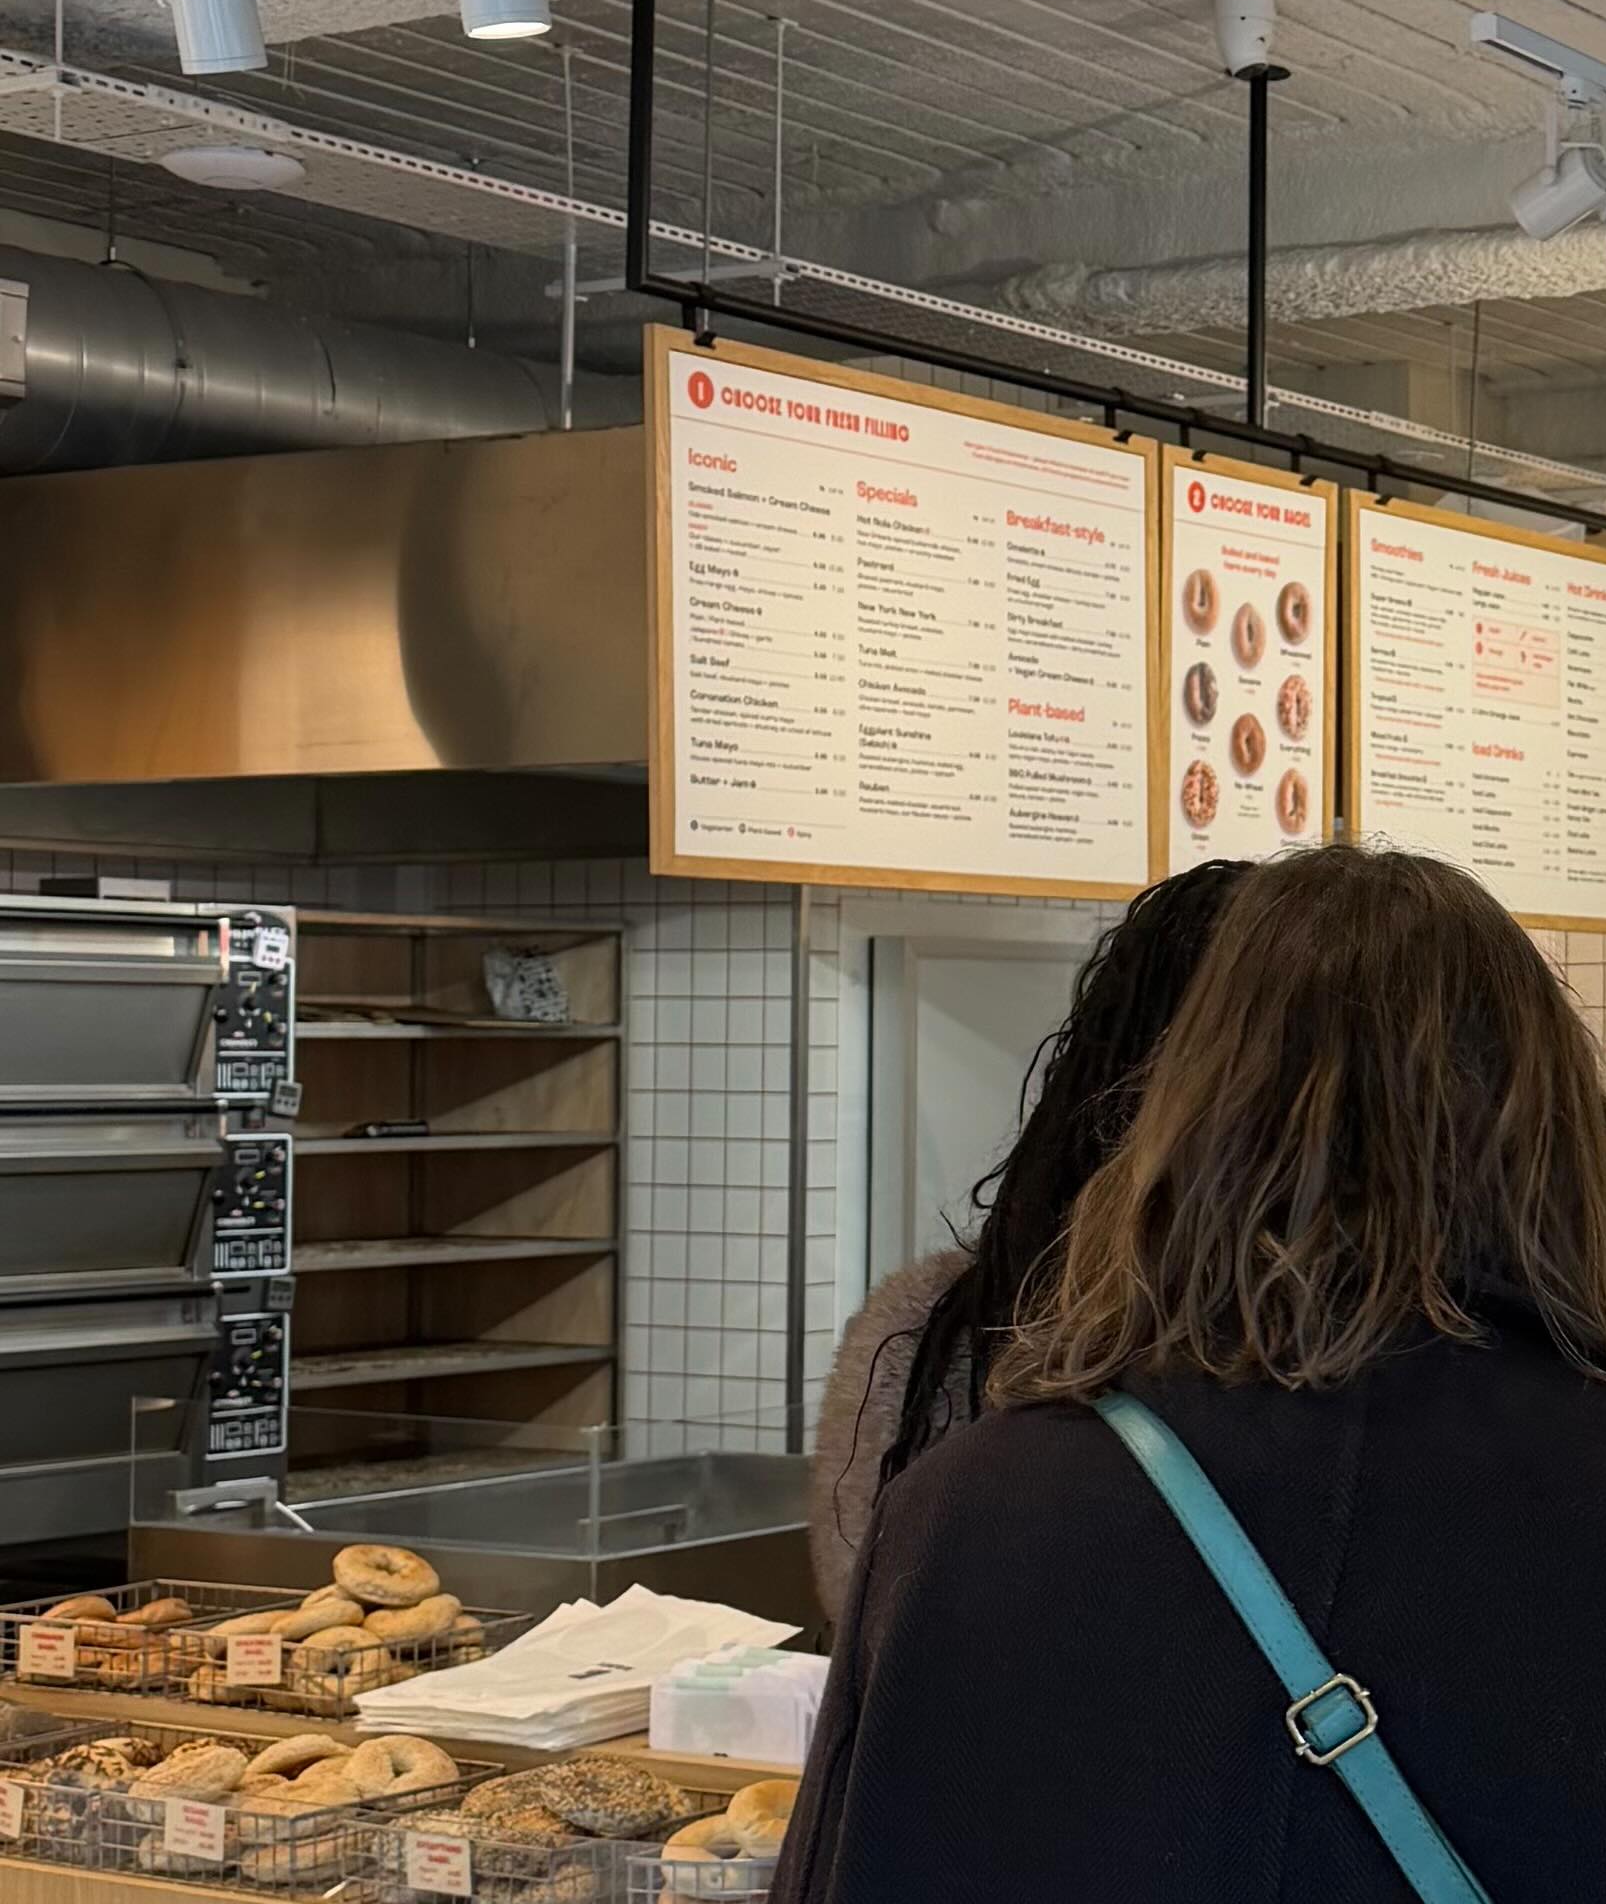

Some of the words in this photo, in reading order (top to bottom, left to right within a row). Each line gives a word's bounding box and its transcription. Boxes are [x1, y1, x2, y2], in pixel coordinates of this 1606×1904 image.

[721, 386, 781, 416] CHOOSE
[788, 401, 820, 424] YOUR
[826, 408, 859, 433] FRESH
[865, 417, 909, 442] FILLING
[687, 446, 736, 473] Iconic
[856, 480, 918, 508] Specials
[1210, 493, 1253, 517] CHOOSE
[1257, 503, 1281, 521] YOUR
[1284, 508, 1312, 528] BAGEL
[1006, 509, 1105, 545] Breakfast-style
[1371, 537, 1422, 562] Smoothies
[689, 560, 704, 574] Egg
[1472, 559, 1498, 578] Fresh
[1567, 582, 1581, 596] Hot
[689, 596, 719, 610] Cream
[690, 689, 740, 704] Coronation
[1008, 696, 1084, 722] Plant-based
